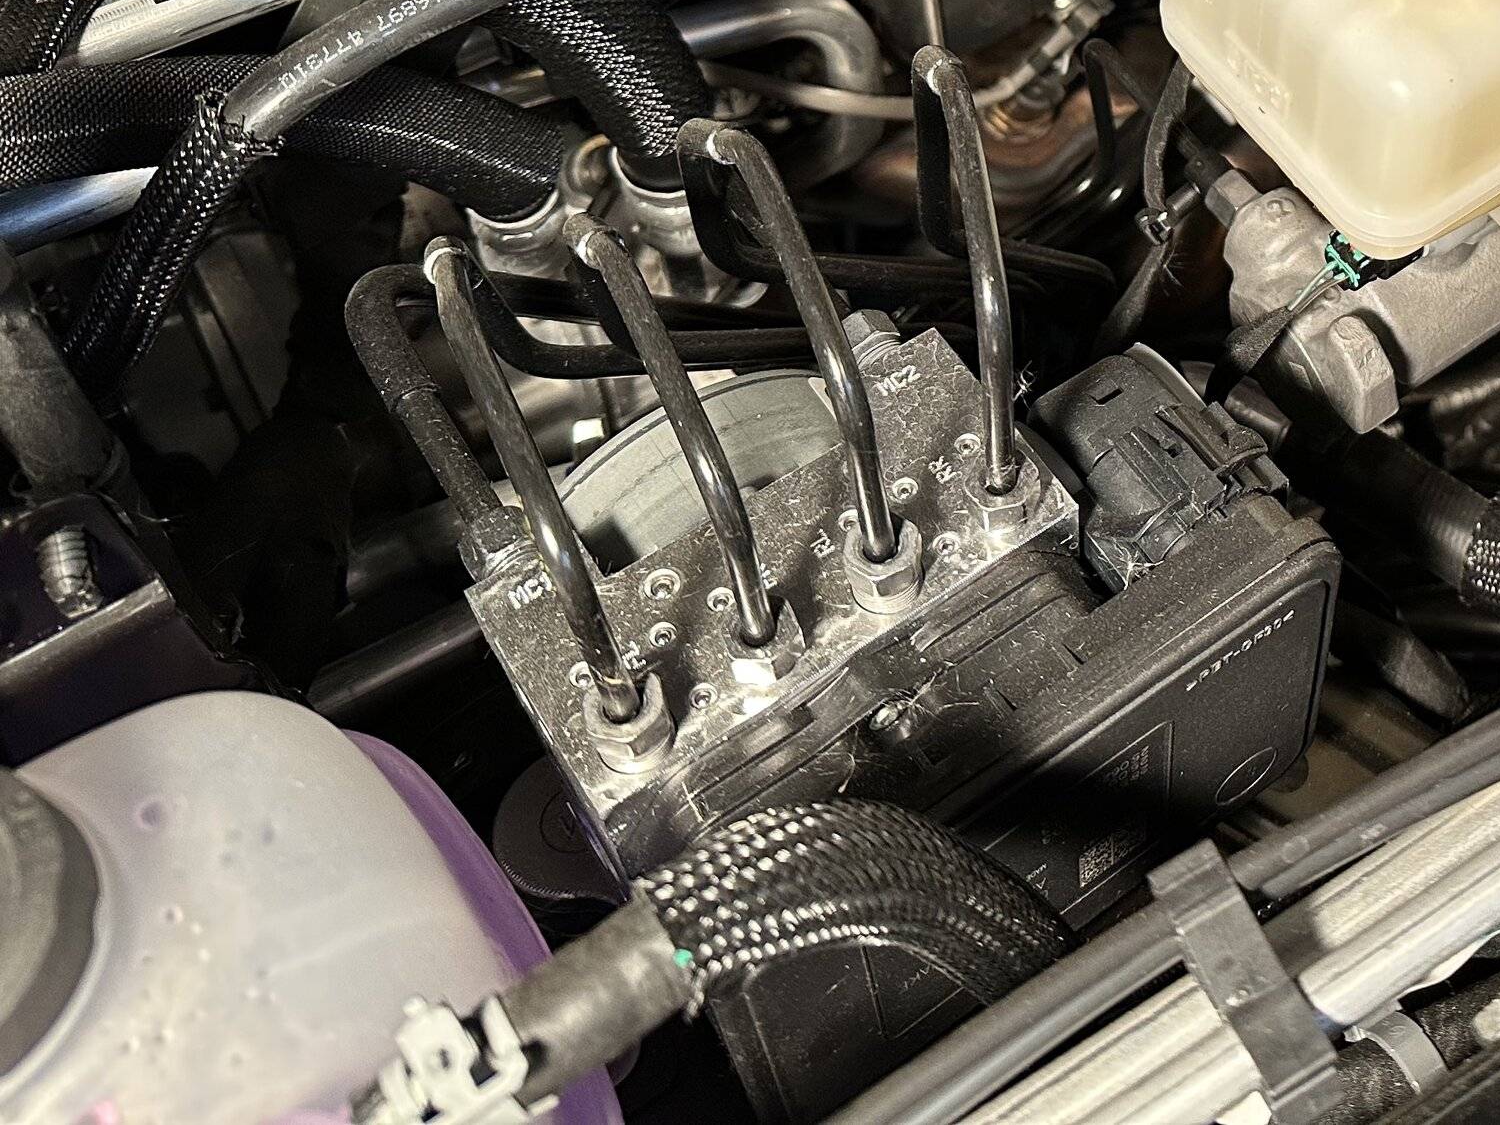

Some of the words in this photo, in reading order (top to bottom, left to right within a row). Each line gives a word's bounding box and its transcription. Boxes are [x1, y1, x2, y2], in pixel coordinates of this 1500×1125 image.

[878, 363, 921, 397] MC2
[928, 455, 957, 484] RR
[810, 528, 836, 558] RL
[507, 571, 553, 610] MC1
[621, 640, 647, 671] FL
